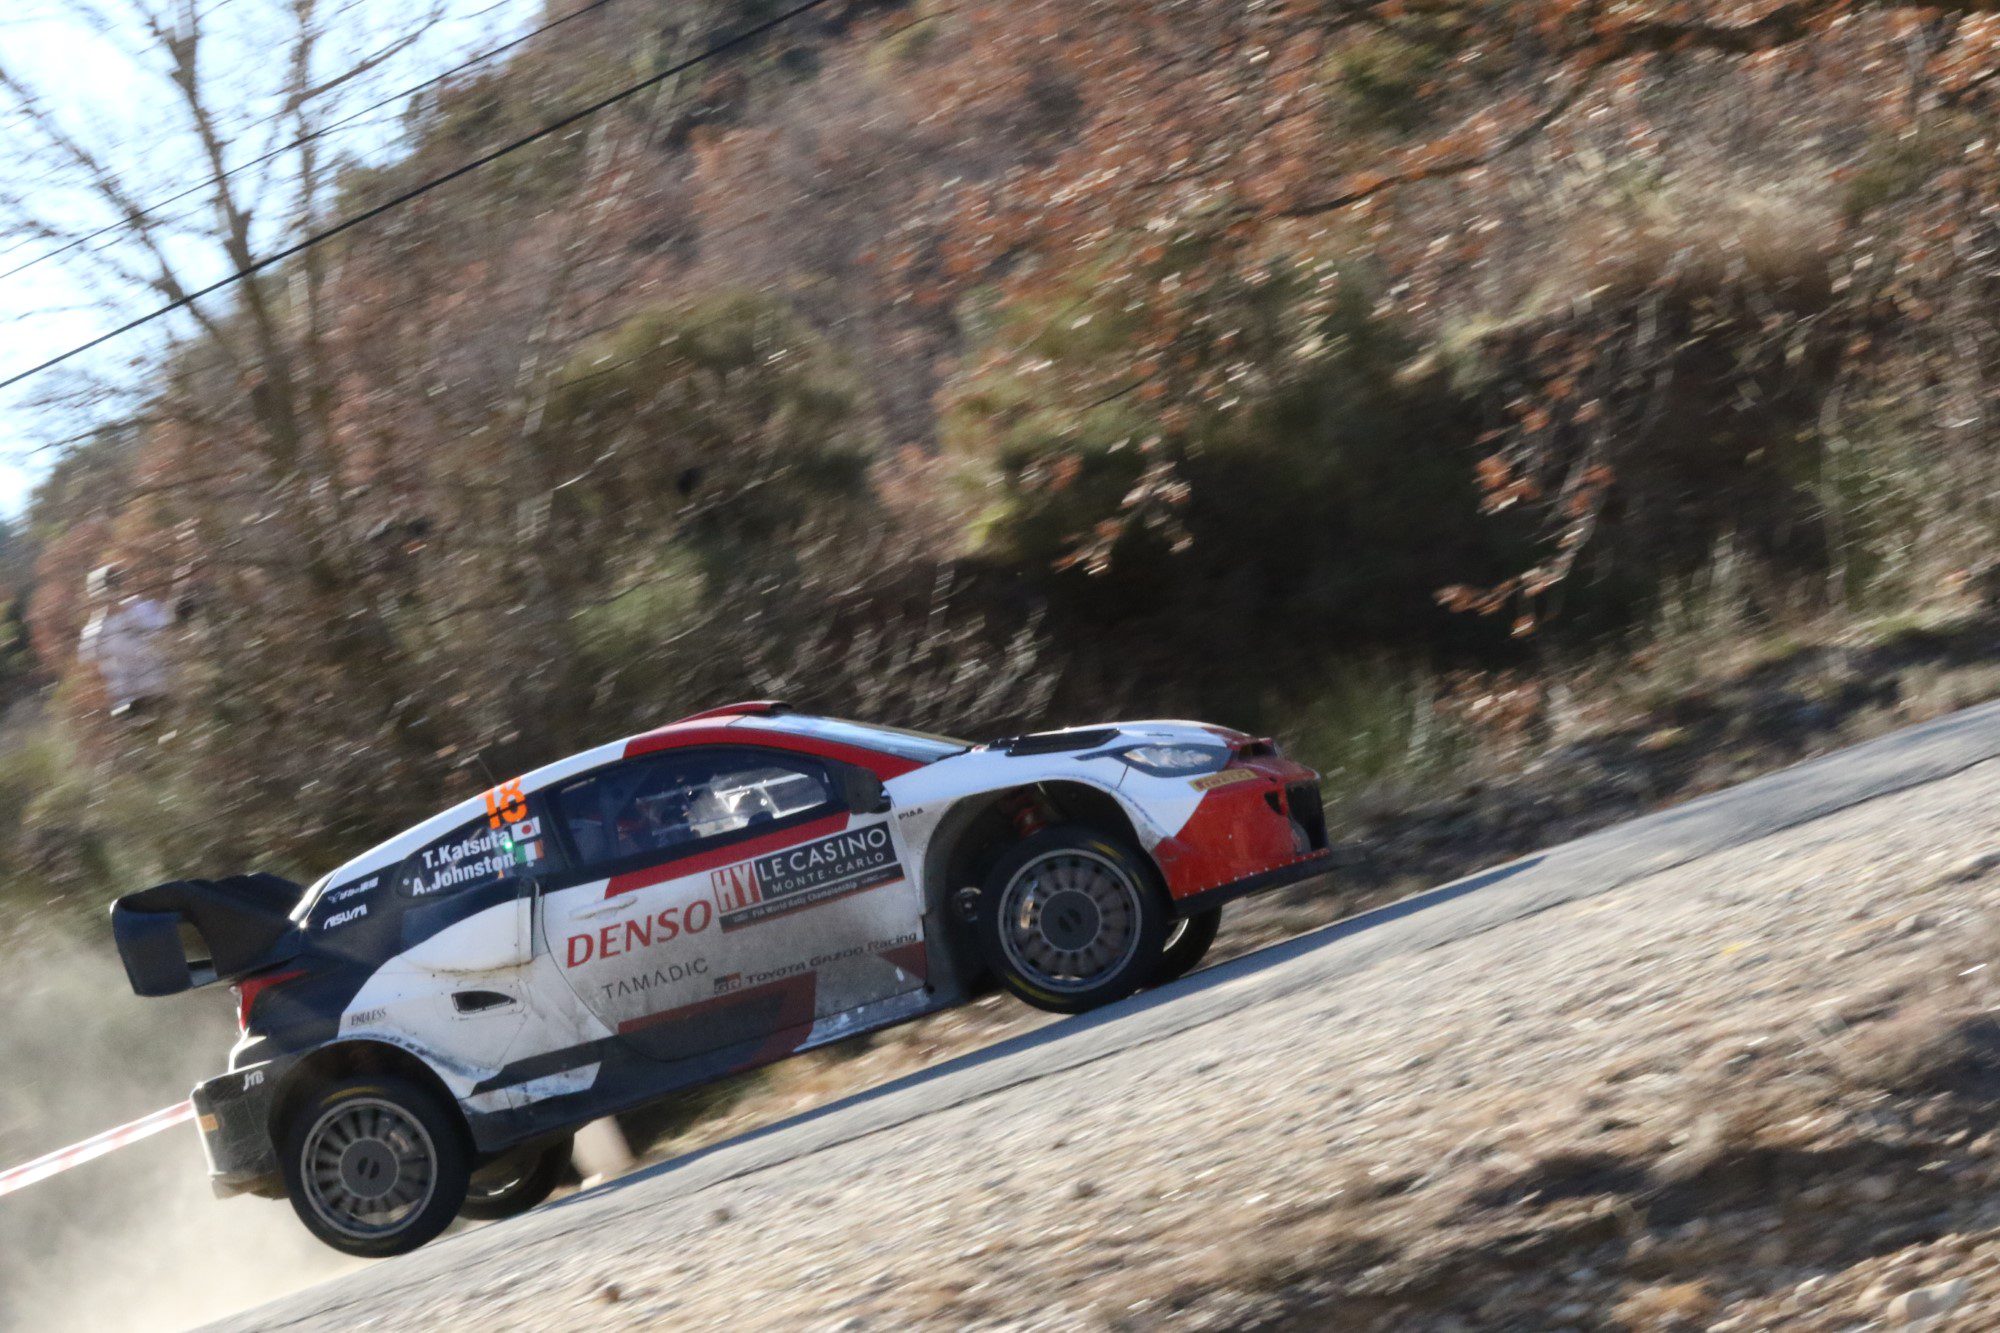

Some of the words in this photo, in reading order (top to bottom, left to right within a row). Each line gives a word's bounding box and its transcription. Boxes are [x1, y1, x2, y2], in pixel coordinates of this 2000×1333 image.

[478, 777, 527, 830] 18
[422, 830, 511, 869] T.Katsuta
[758, 857, 786, 882] LE
[789, 828, 887, 871] CASINO
[412, 852, 517, 897] A.Johnston
[807, 881, 858, 903] Championship
[566, 899, 712, 968] DENSO
[601, 957, 709, 1000] TAMADIC
[746, 961, 806, 985] TOYOTA
[867, 932, 917, 951] Racing
[351, 1007, 387, 1026] ENDLESS
